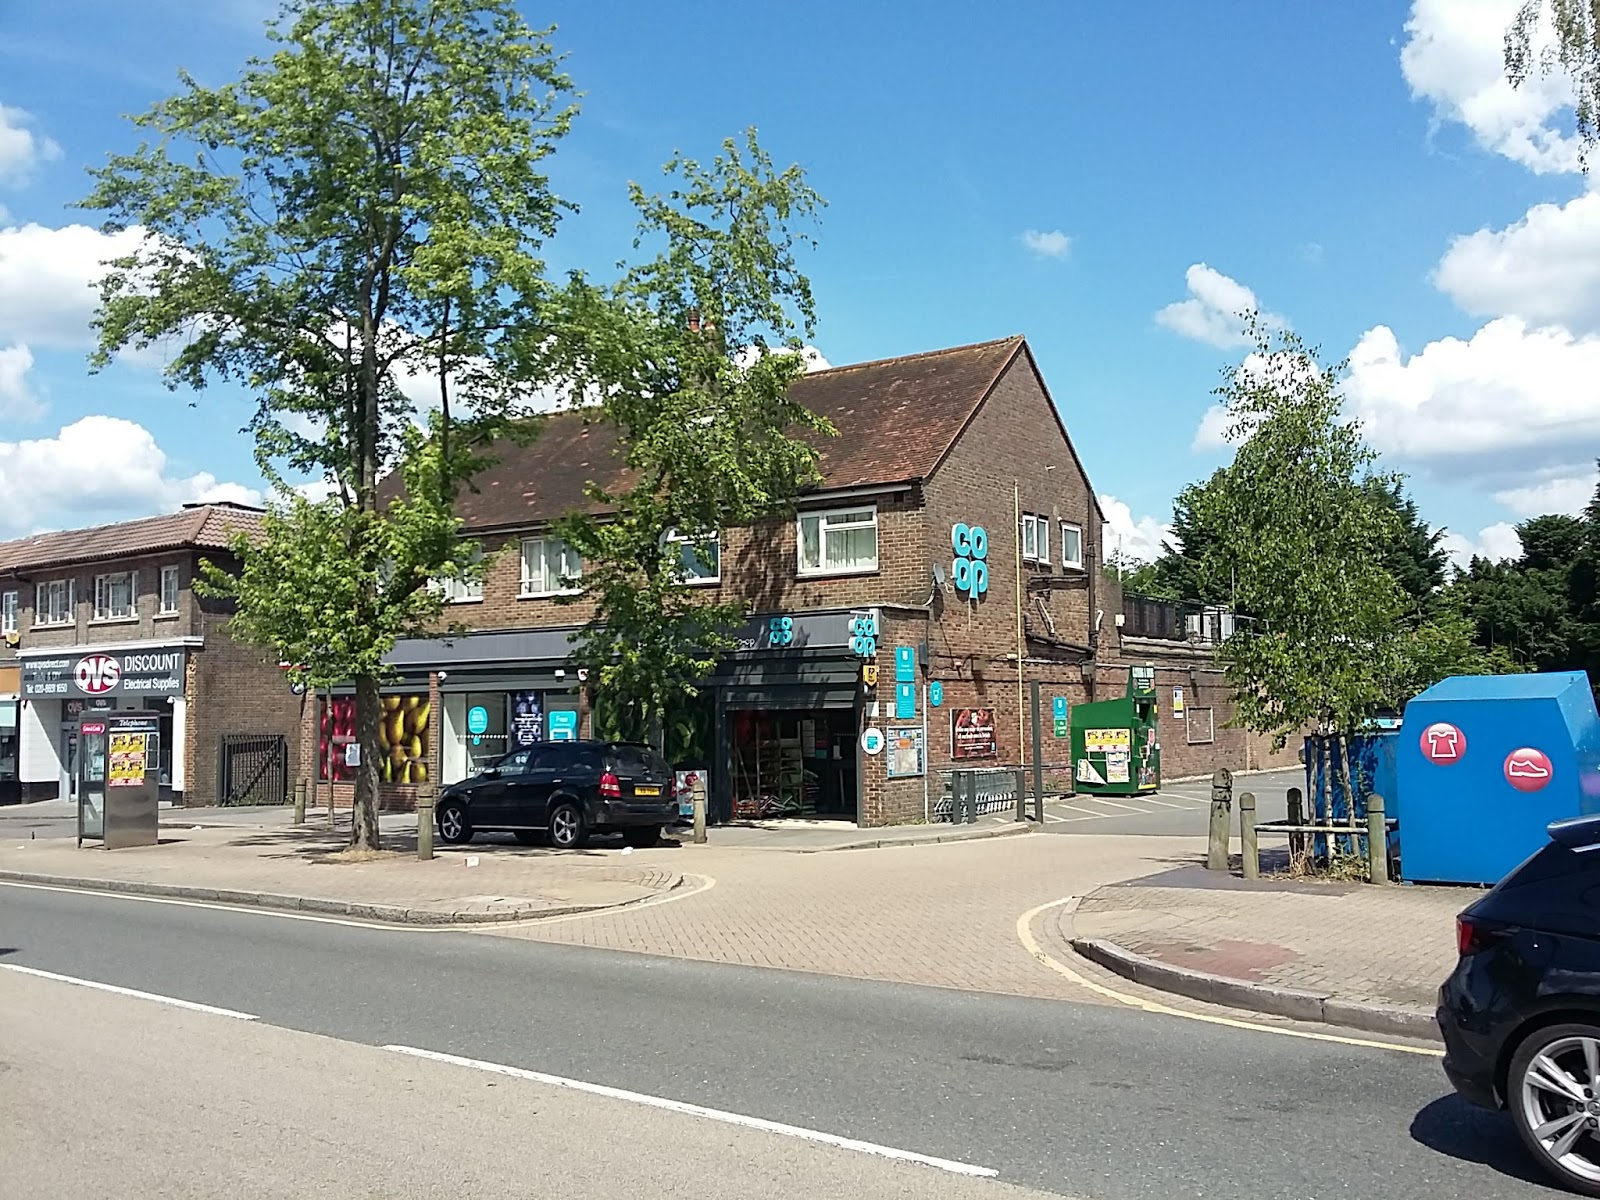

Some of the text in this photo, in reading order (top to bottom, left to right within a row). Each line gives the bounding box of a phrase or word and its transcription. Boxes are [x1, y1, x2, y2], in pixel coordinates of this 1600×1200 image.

[124, 653, 180, 672] DISCOUNT
[76, 656, 119, 690] QVS
[123, 676, 180, 691] Electrical Supplies
